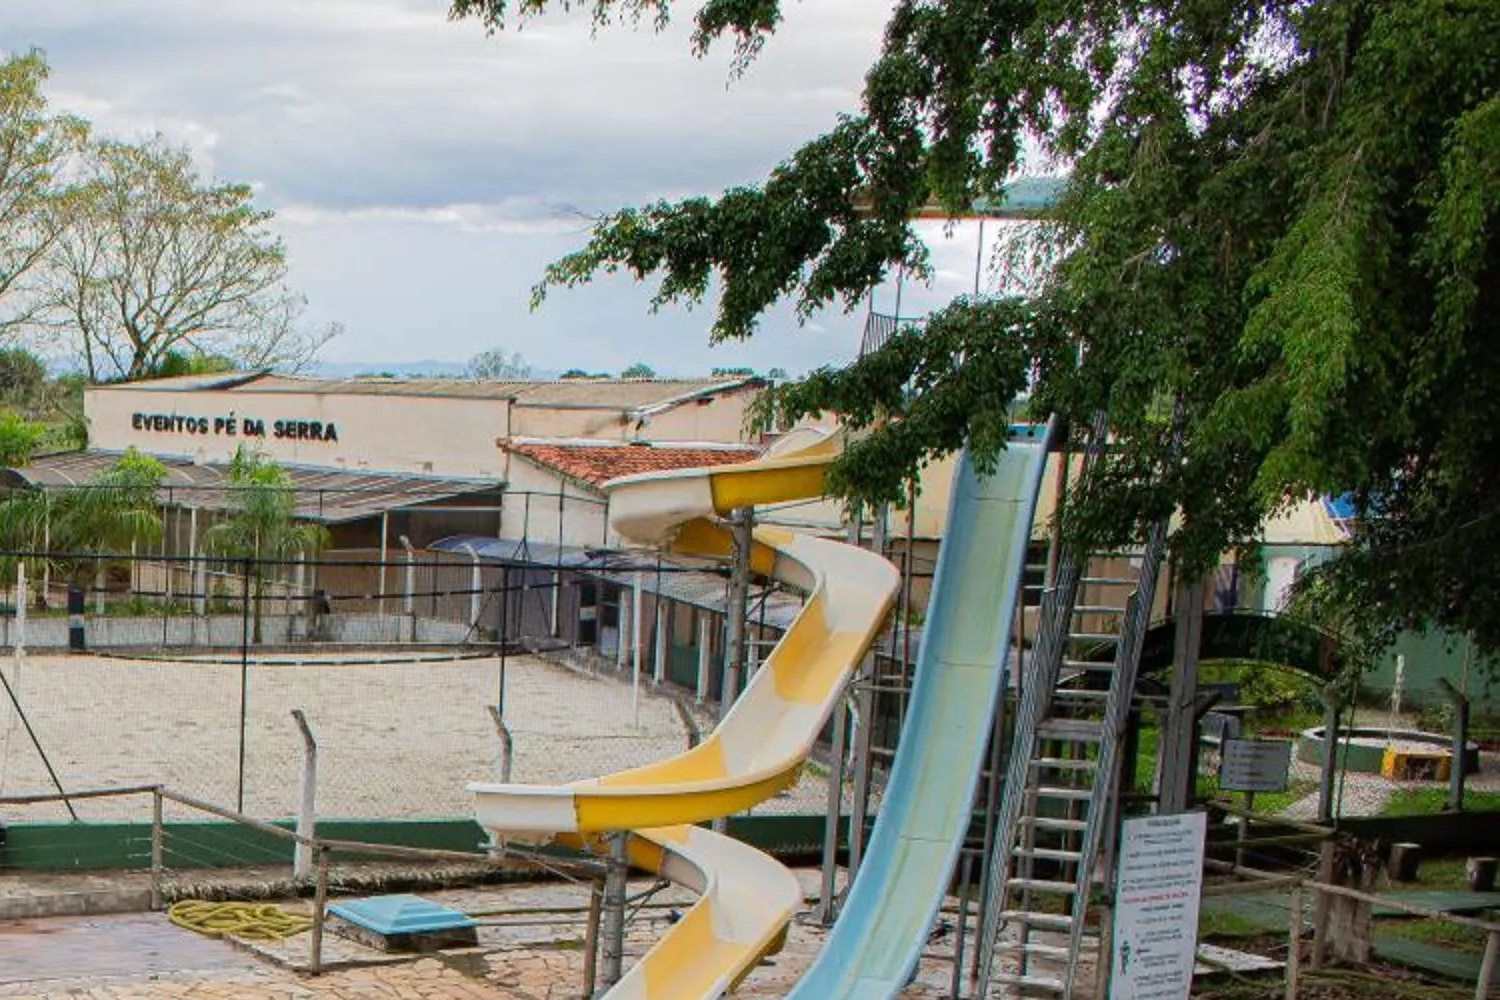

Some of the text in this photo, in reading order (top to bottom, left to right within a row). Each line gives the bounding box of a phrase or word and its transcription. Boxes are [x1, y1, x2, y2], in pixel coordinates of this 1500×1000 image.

[131, 411, 338, 441] EVENTOS PÉ DA SERRA
